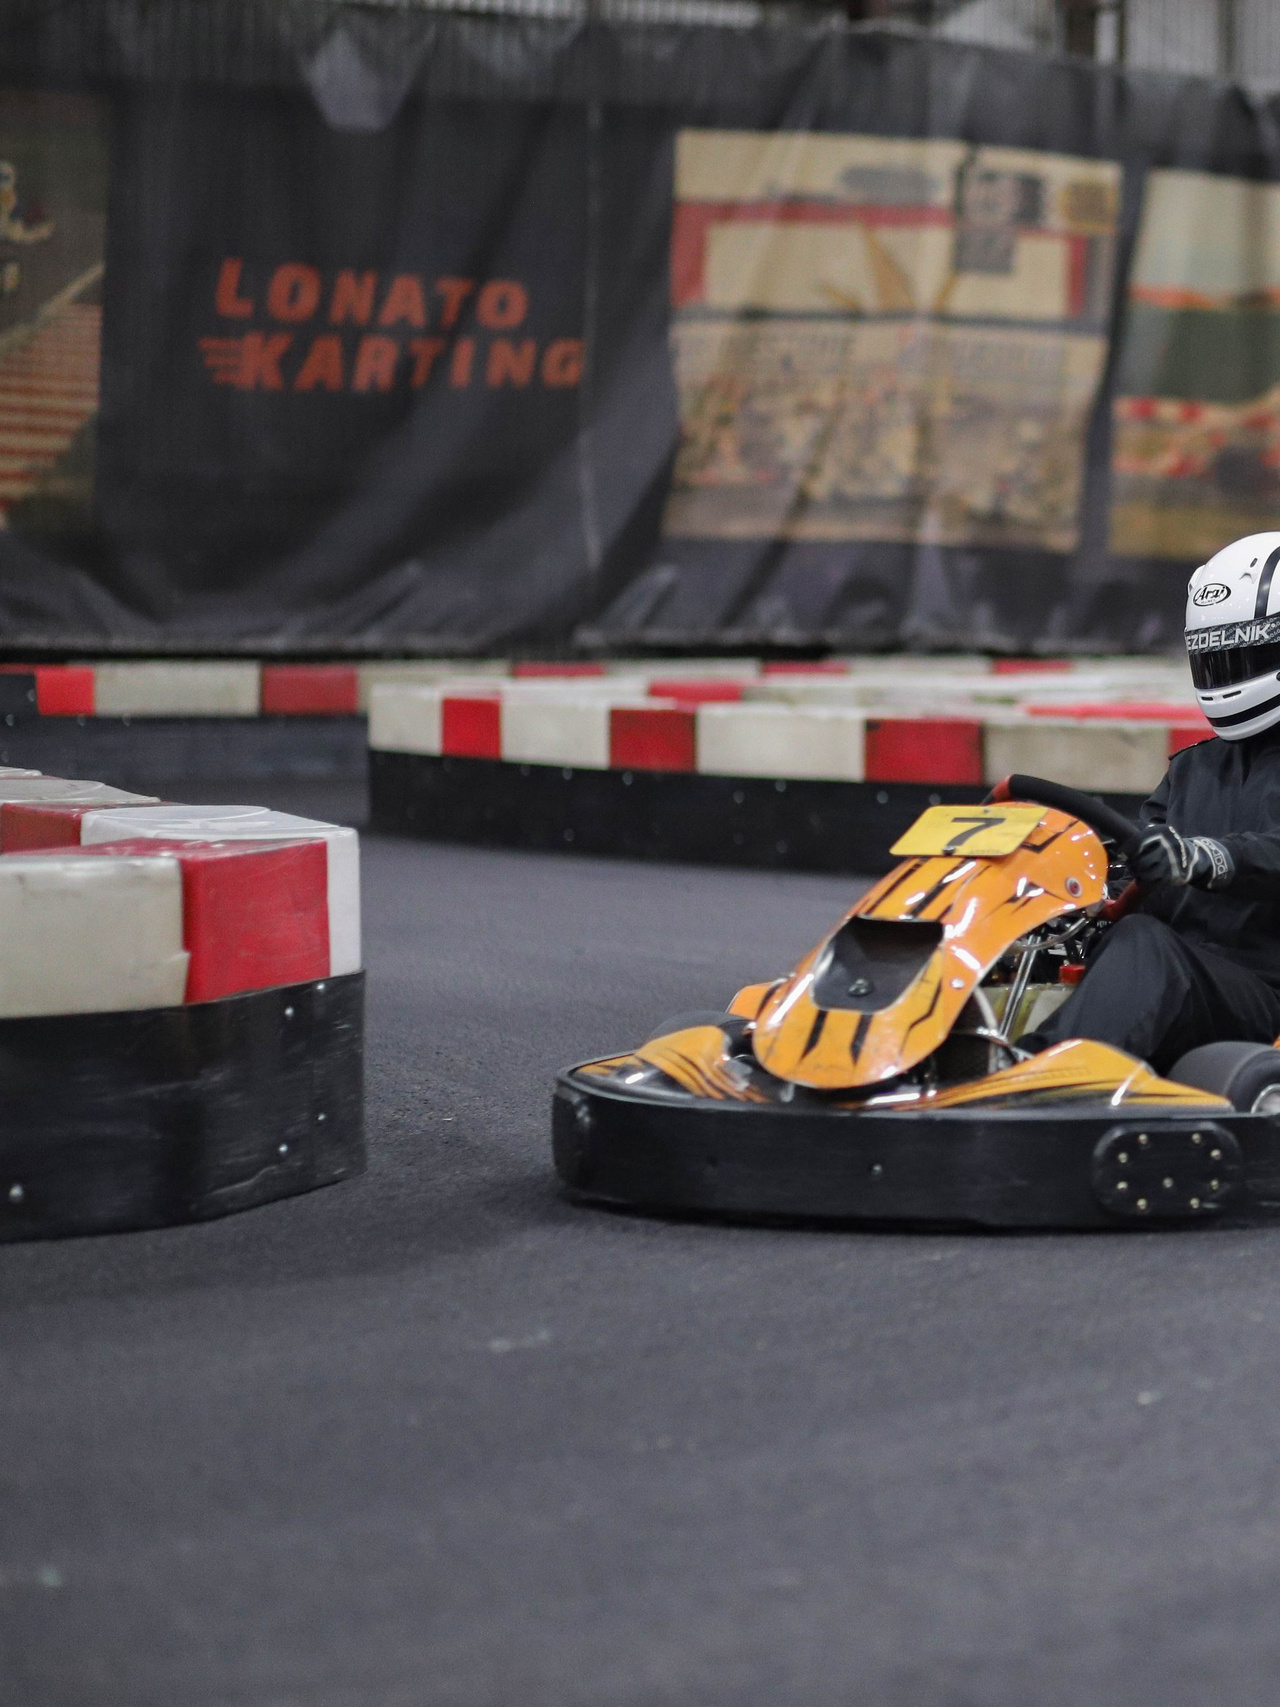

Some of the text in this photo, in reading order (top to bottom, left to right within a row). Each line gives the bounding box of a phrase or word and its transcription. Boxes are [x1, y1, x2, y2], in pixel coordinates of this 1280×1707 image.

[214, 257, 529, 330] LONATO
[203, 331, 585, 391] KARTING
[1198, 586, 1226, 600] Arai
[946, 817, 1006, 847] 7
